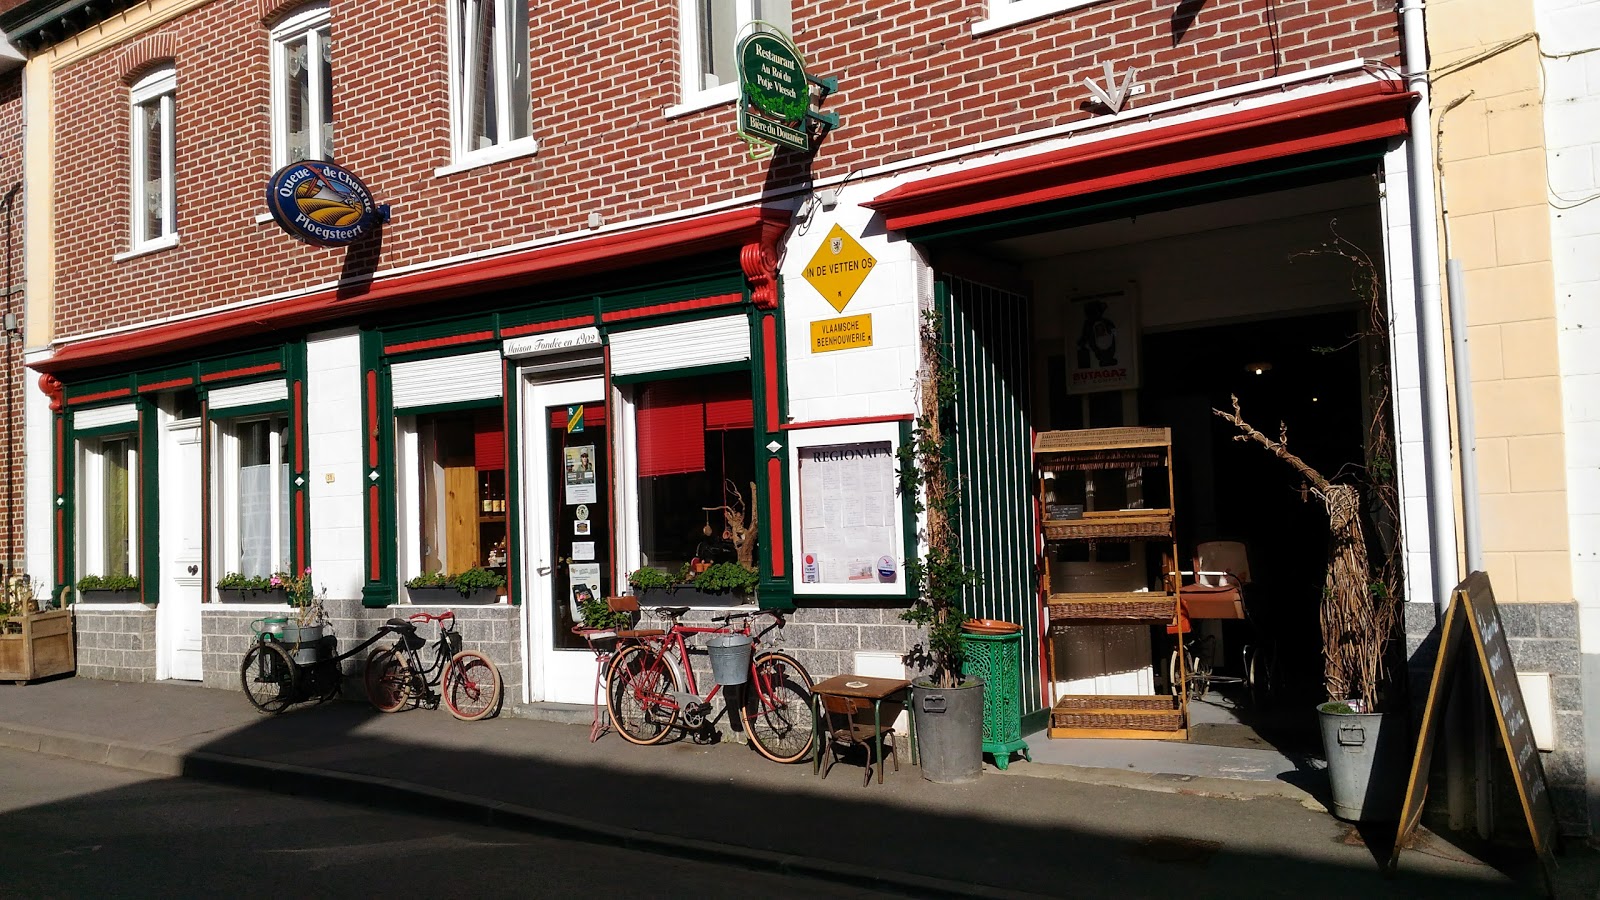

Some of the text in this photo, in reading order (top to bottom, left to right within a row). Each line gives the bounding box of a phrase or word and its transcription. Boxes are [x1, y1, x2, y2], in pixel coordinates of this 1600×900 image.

[755, 43, 795, 71] Restaurant
[761, 63, 792, 83] Au Roi du
[757, 74, 796, 98] Potje Vleesch
[750, 116, 804, 145] Bière du Douanier
[280, 166, 372, 214] Queue de Charrue
[295, 212, 363, 240] Ploegsteert
[806, 257, 873, 278] IN DE VETTEN OS
[822, 320, 859, 334] VLAAMSCHE
[507, 332, 596, 354] Maison Fondée en 1902
[817, 332, 866, 347] BEENHOUWERIE
[1072, 368, 1127, 381] BUTAGAZ
[813, 447, 892, 463] REGIONAUX
